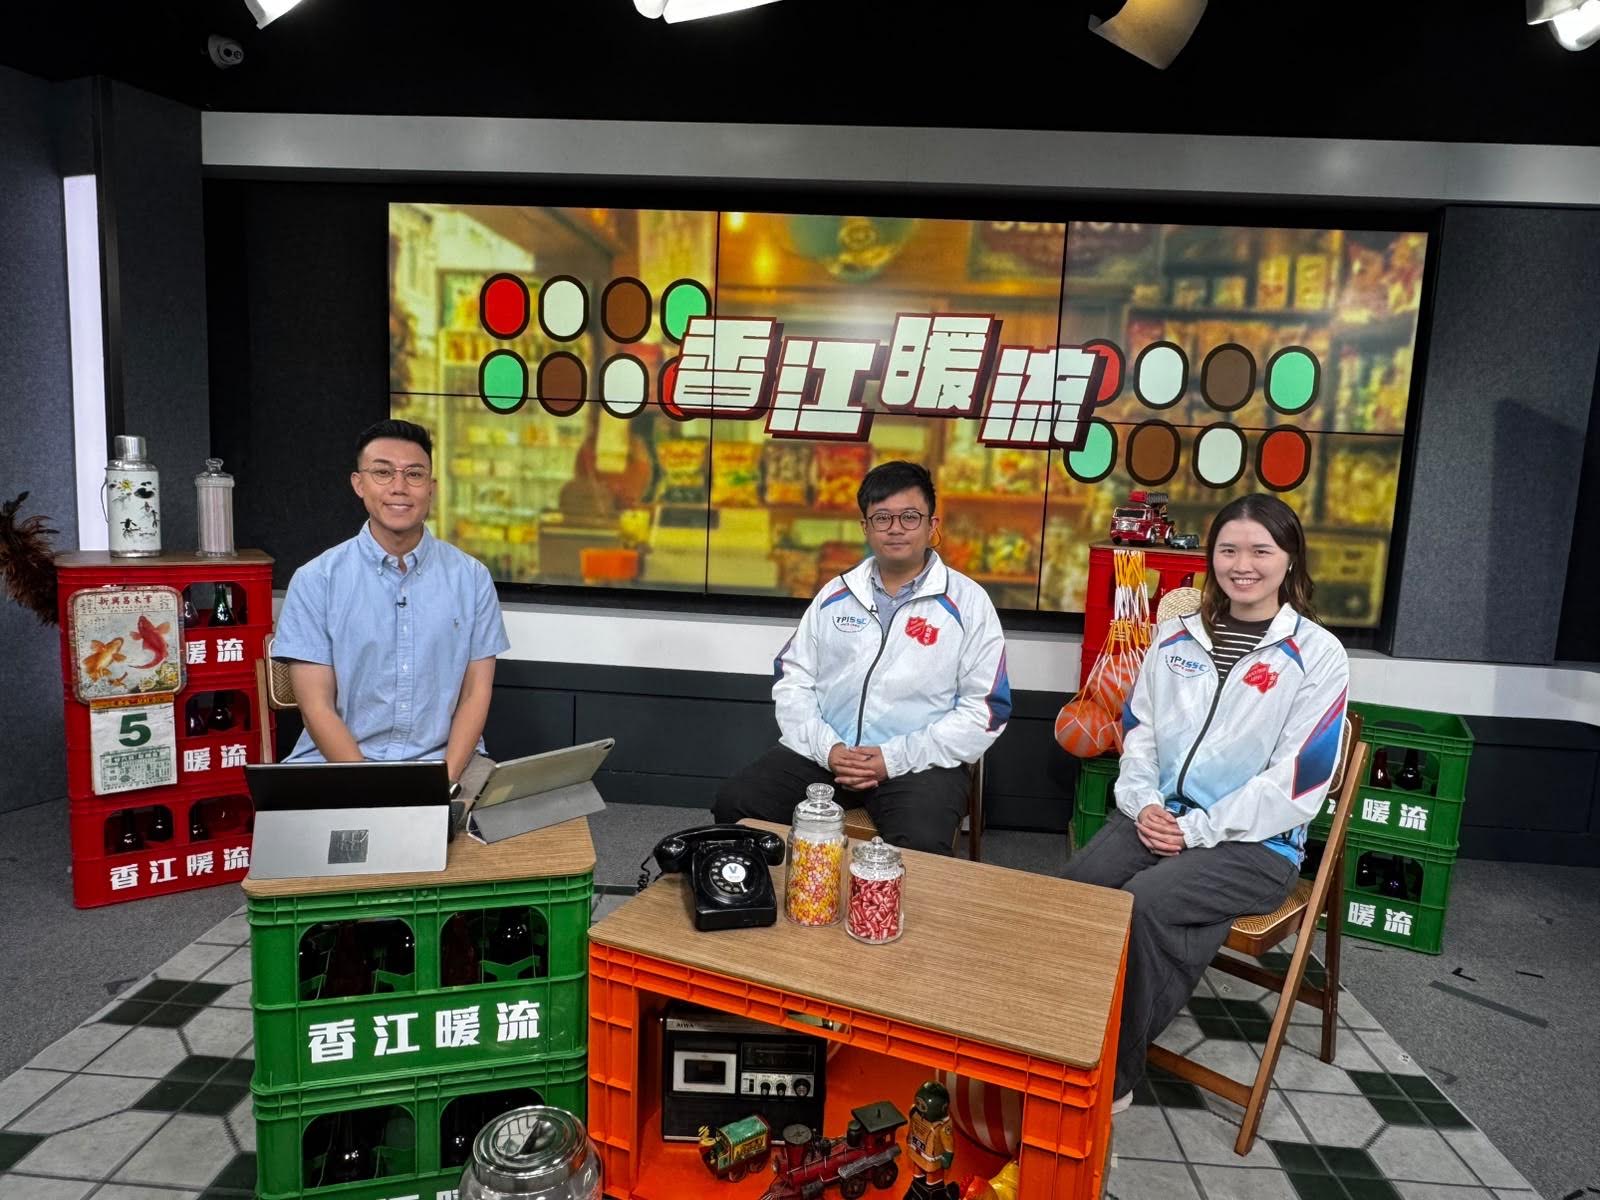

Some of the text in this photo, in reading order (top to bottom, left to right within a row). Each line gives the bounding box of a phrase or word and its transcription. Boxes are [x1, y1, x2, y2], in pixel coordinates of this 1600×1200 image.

[672, 313, 1102, 446] 香江暖流
[119, 712, 152, 747] 5
[183, 744, 248, 772] 暖流
[1326, 797, 1429, 831] 暖流
[109, 846, 250, 891] 香江暖流
[1347, 901, 1414, 936] 暖流
[308, 1000, 541, 1064] 香江暖流
